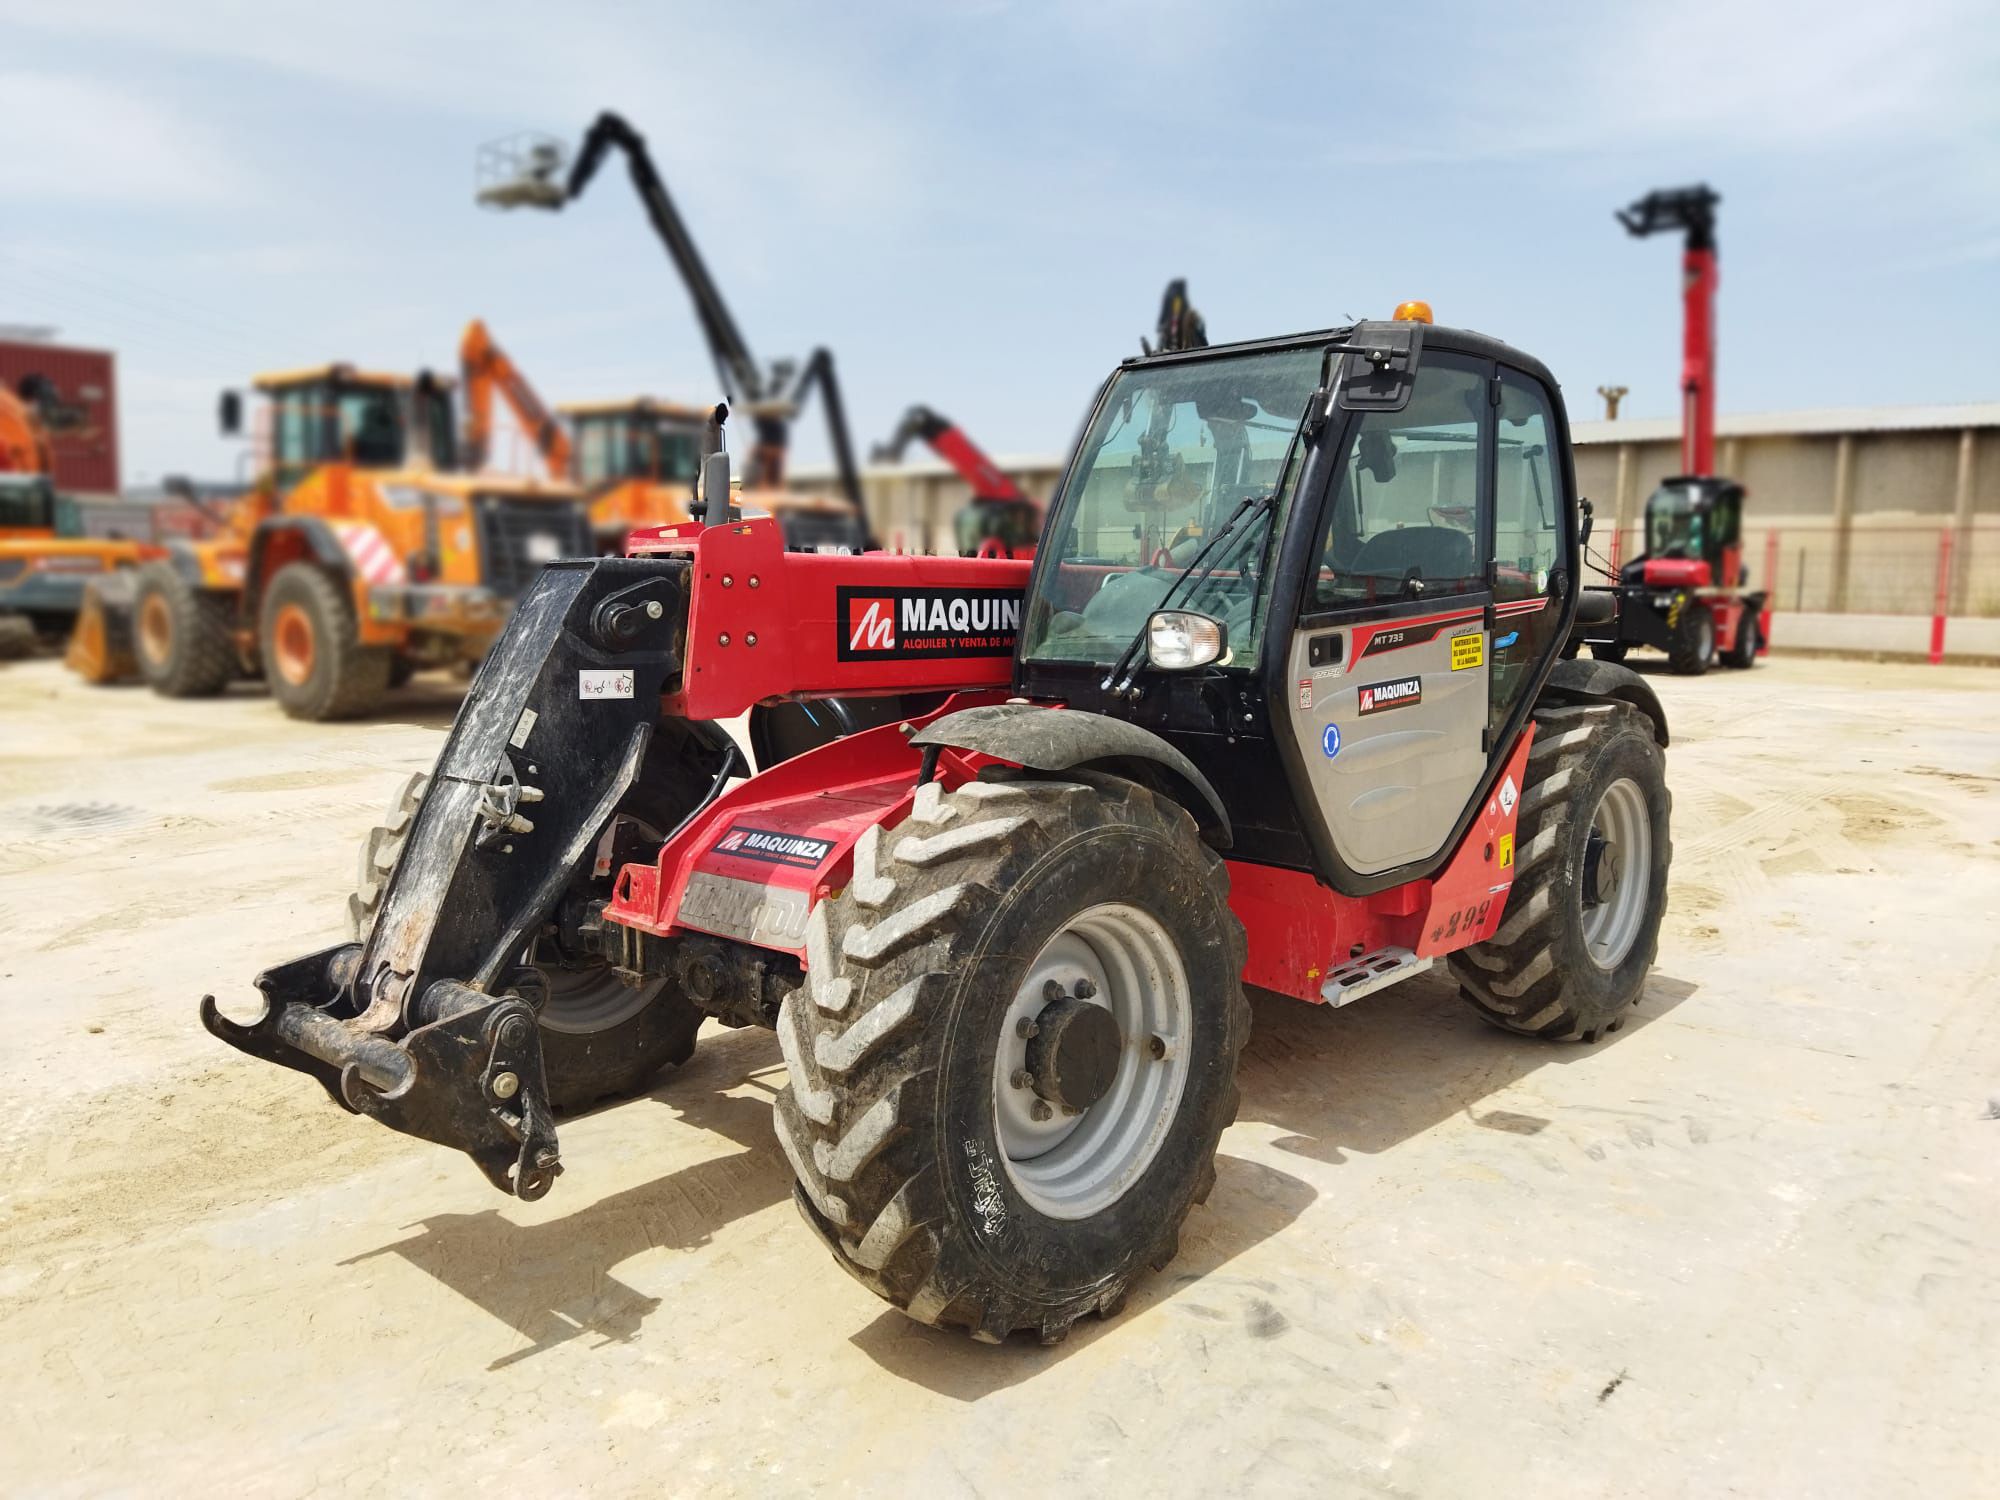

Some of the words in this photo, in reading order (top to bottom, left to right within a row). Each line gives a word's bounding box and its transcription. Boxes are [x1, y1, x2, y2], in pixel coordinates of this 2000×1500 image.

[902, 598, 1024, 633] MAQUIN
[903, 638, 947, 649] ALQUILER
[950, 638, 956, 648] Y
[959, 637, 987, 648] VENTA
[989, 637, 1001, 647] DE
[1374, 636, 1387, 646] MT
[1388, 632, 1404, 644] 733
[1374, 681, 1420, 702] MAQUINZA
[743, 833, 829, 860] MAQUINZA
